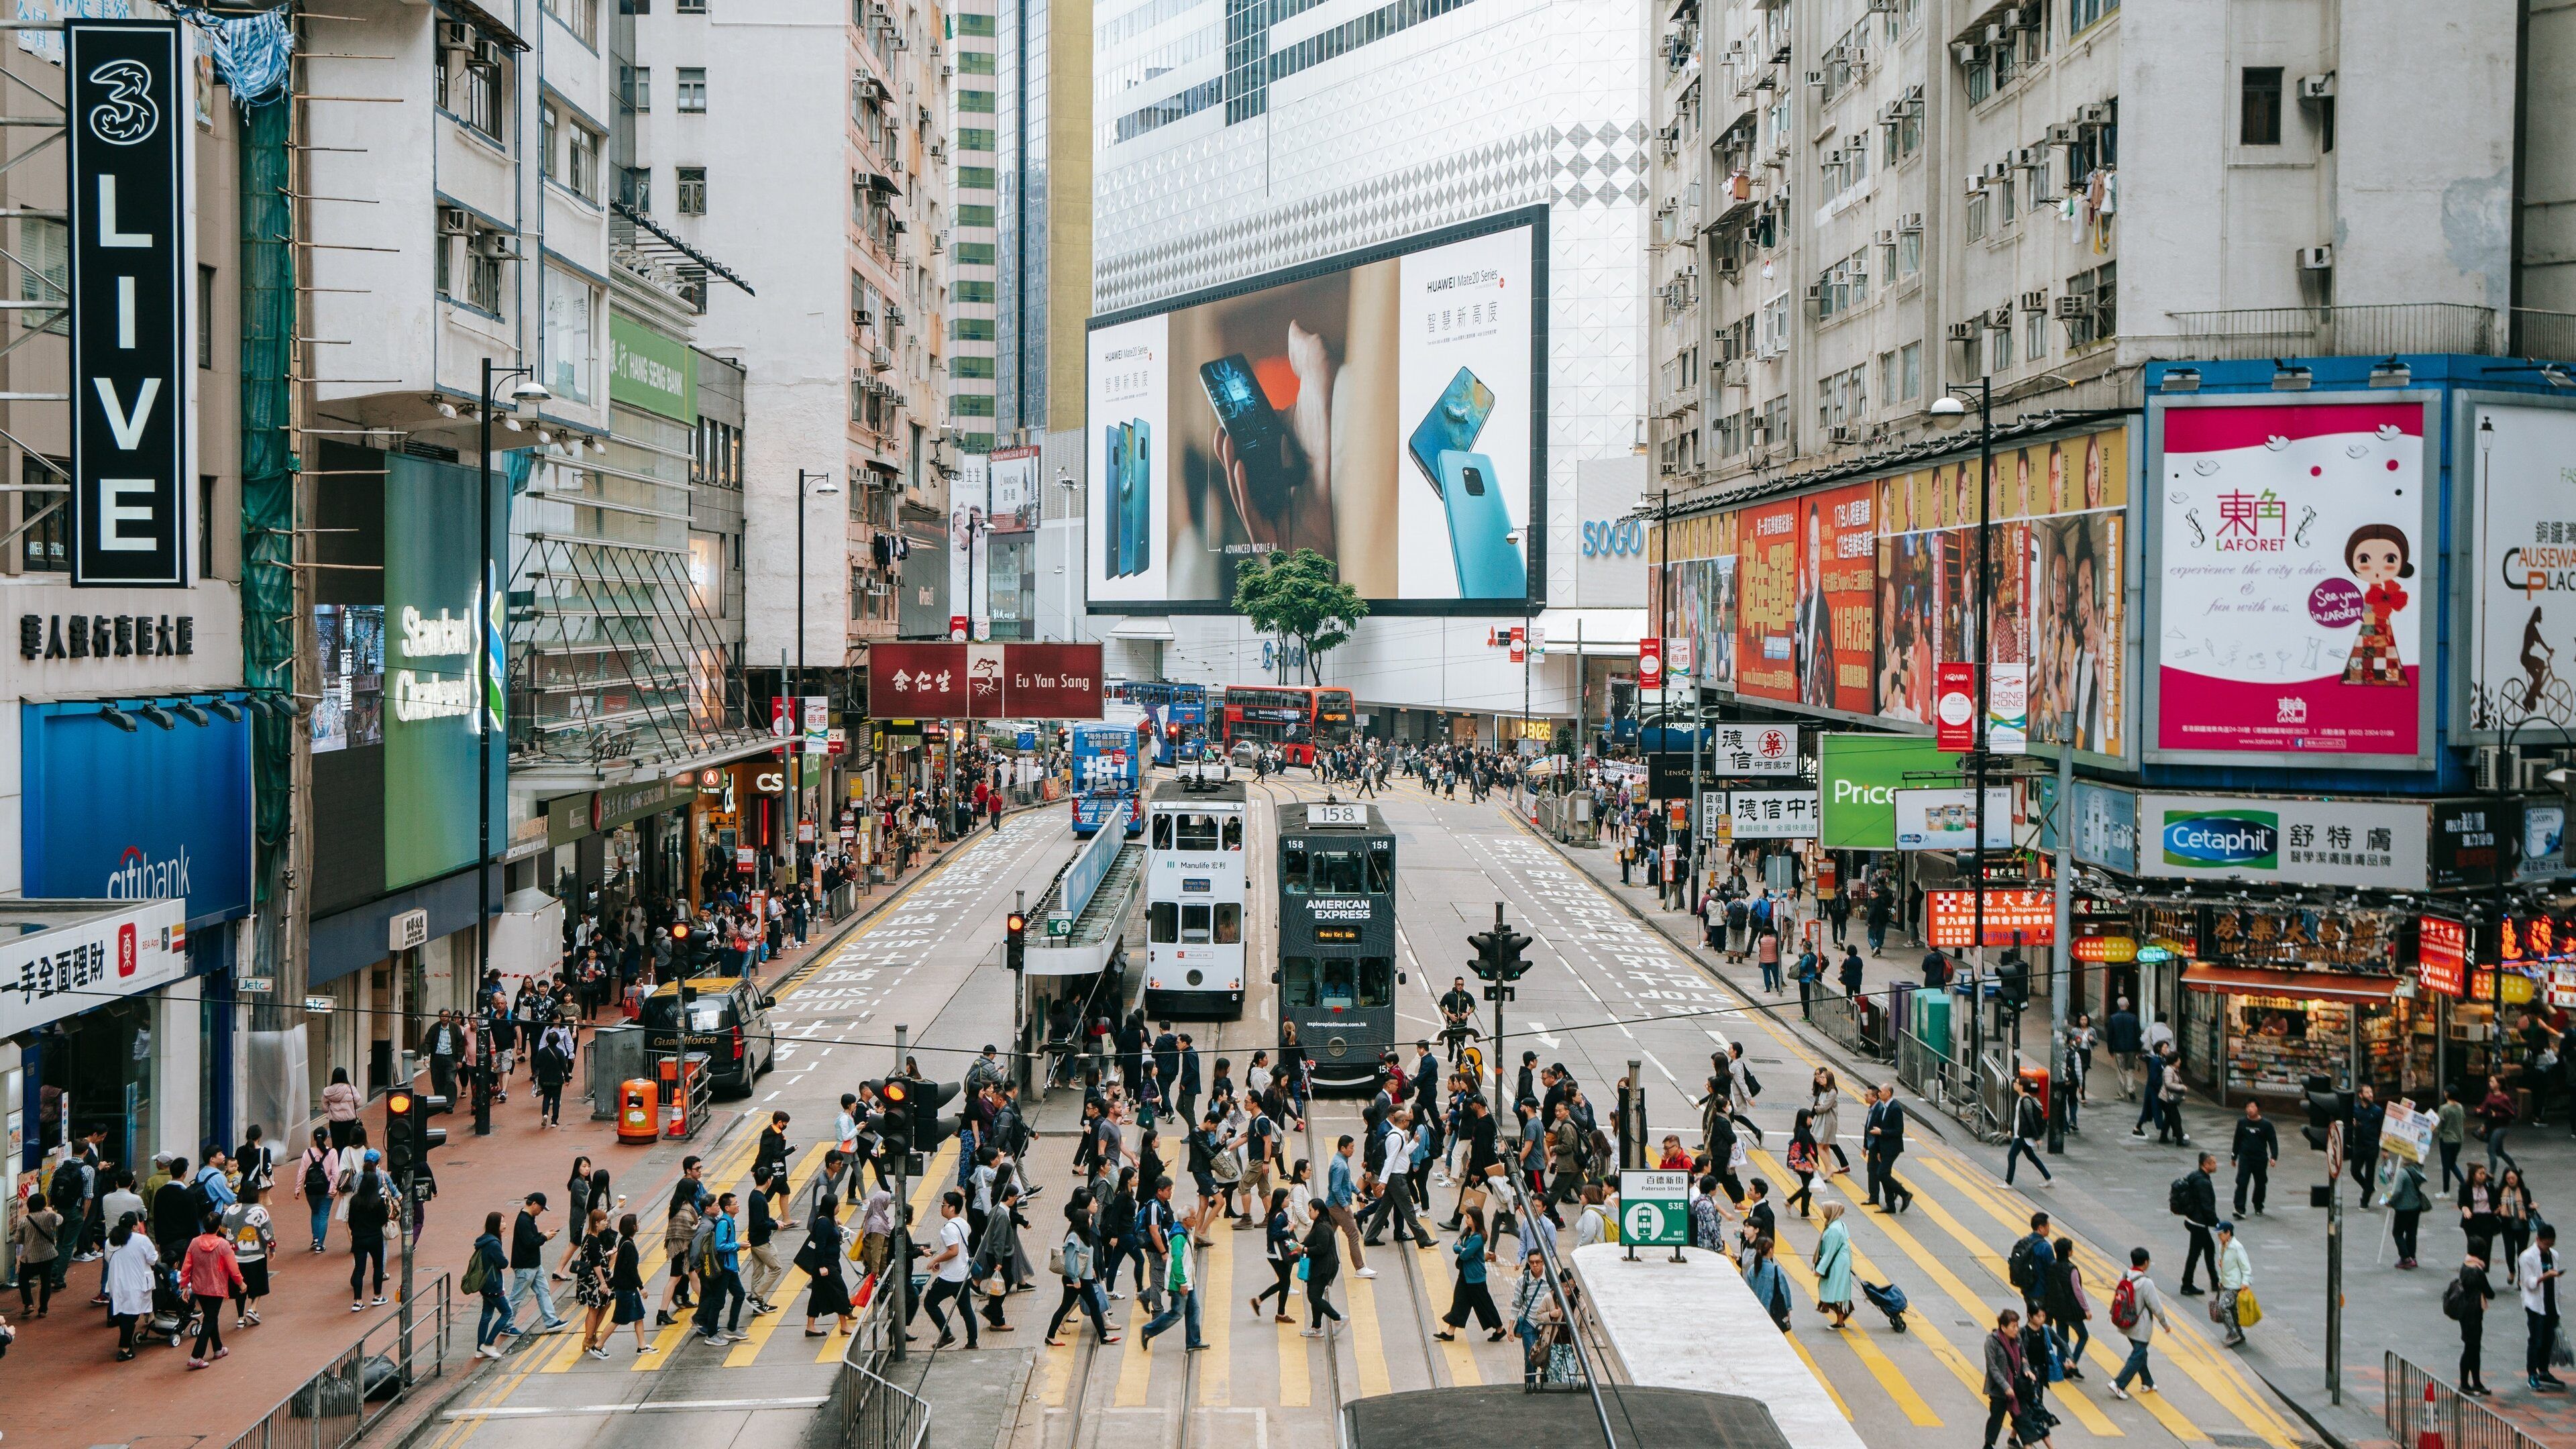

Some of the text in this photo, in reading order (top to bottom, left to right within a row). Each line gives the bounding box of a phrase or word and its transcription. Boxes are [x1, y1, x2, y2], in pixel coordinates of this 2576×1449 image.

[1428, 268, 1497, 293] HUAWEI Mate20 Series
[1428, 301, 1497, 333] 智慧新高度
[1106, 350, 1123, 362] HUAWEI
[1138, 345, 1148, 356] Series
[93, 174, 162, 552] LIVE
[630, 352, 683, 397] HANG SENG BANK
[1106, 370, 1148, 393] 智慧新高度
[961, 467, 981, 483] 生生
[1582, 520, 1643, 556] SOGO
[2216, 538, 2286, 552] LAFORET
[1225, 543, 1277, 553] ADVANCED MOBILE AI
[2169, 562, 2326, 578] experience the city chic
[2315, 589, 2361, 608] See you
[2204, 599, 2238, 616] fun
[2241, 600, 2265, 612] with
[401, 605, 470, 657] Standard
[1833, 605, 1872, 652] 11月23日
[20, 614, 194, 660] 華人銀行東區大廈
[1671, 655, 1688, 663] 香港
[892, 669, 952, 694] 余仁生
[1016, 674, 1089, 691] Eu Yan Sang
[395, 668, 470, 722] Chartered
[807, 714, 826, 723] 香港
[1762, 733, 1783, 757] 藥
[1754, 760, 1792, 770] 中西藥坊
[1321, 806, 1355, 822] 158
[1737, 824, 1769, 833] 連鎖經營
[1287, 840, 1303, 849] 158
[1371, 841, 1388, 849] 158
[2172, 826, 2269, 857] Cetaphil
[2290, 824, 2392, 851] 舒特膚
[106, 843, 191, 898] citibank
[1211, 861, 1226, 869] 宏利
[909, 888, 983, 898] STOP
[896, 898, 963, 911] 巴士
[1305, 900, 1370, 909] AMERICAN
[1983, 906, 2006, 914] heung
[885, 912, 940, 926] 站
[1315, 910, 1371, 919] EXPRESS
[862, 928, 936, 939] BUS
[142, 938, 159, 950] BEA App
[842, 938, 931, 951] STOP
[826, 951, 908, 967] 巴士
[1, 940, 105, 1005] 一手全面理財
[816, 967, 879, 983] 站
[788, 987, 873, 1000] BUS
[769, 999, 868, 1014] STOP
[653, 1036, 717, 1046] Guaforce
[1646, 1175, 1684, 1185] 百德新街
[1668, 1202, 1684, 1210] 53E
